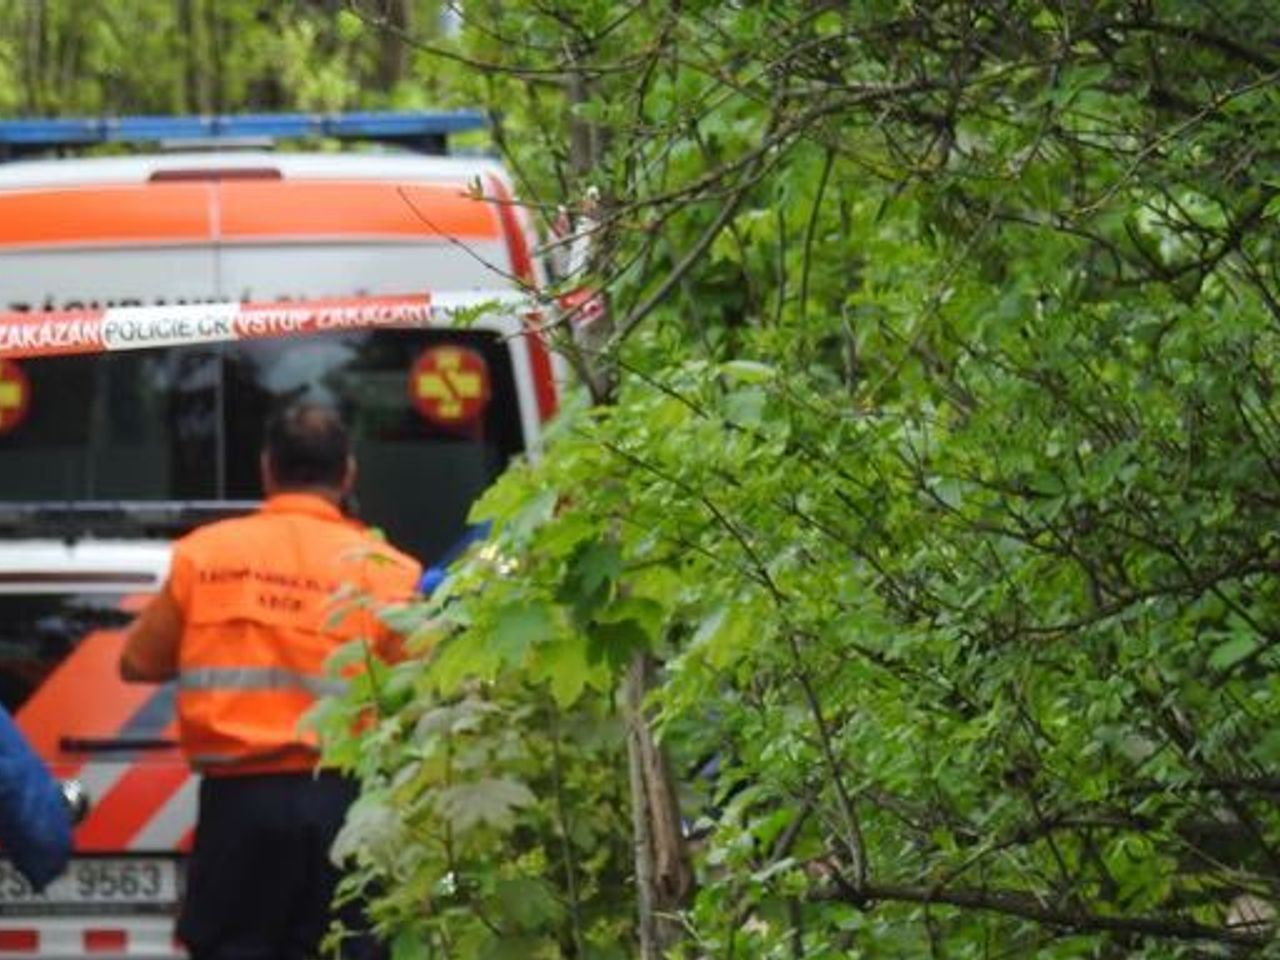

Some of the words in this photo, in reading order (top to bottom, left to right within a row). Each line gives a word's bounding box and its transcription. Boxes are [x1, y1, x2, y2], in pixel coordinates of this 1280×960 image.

[105, 317, 192, 343] POLICIE
[235, 309, 307, 336] VSTUP
[76, 862, 162, 898] 9563
